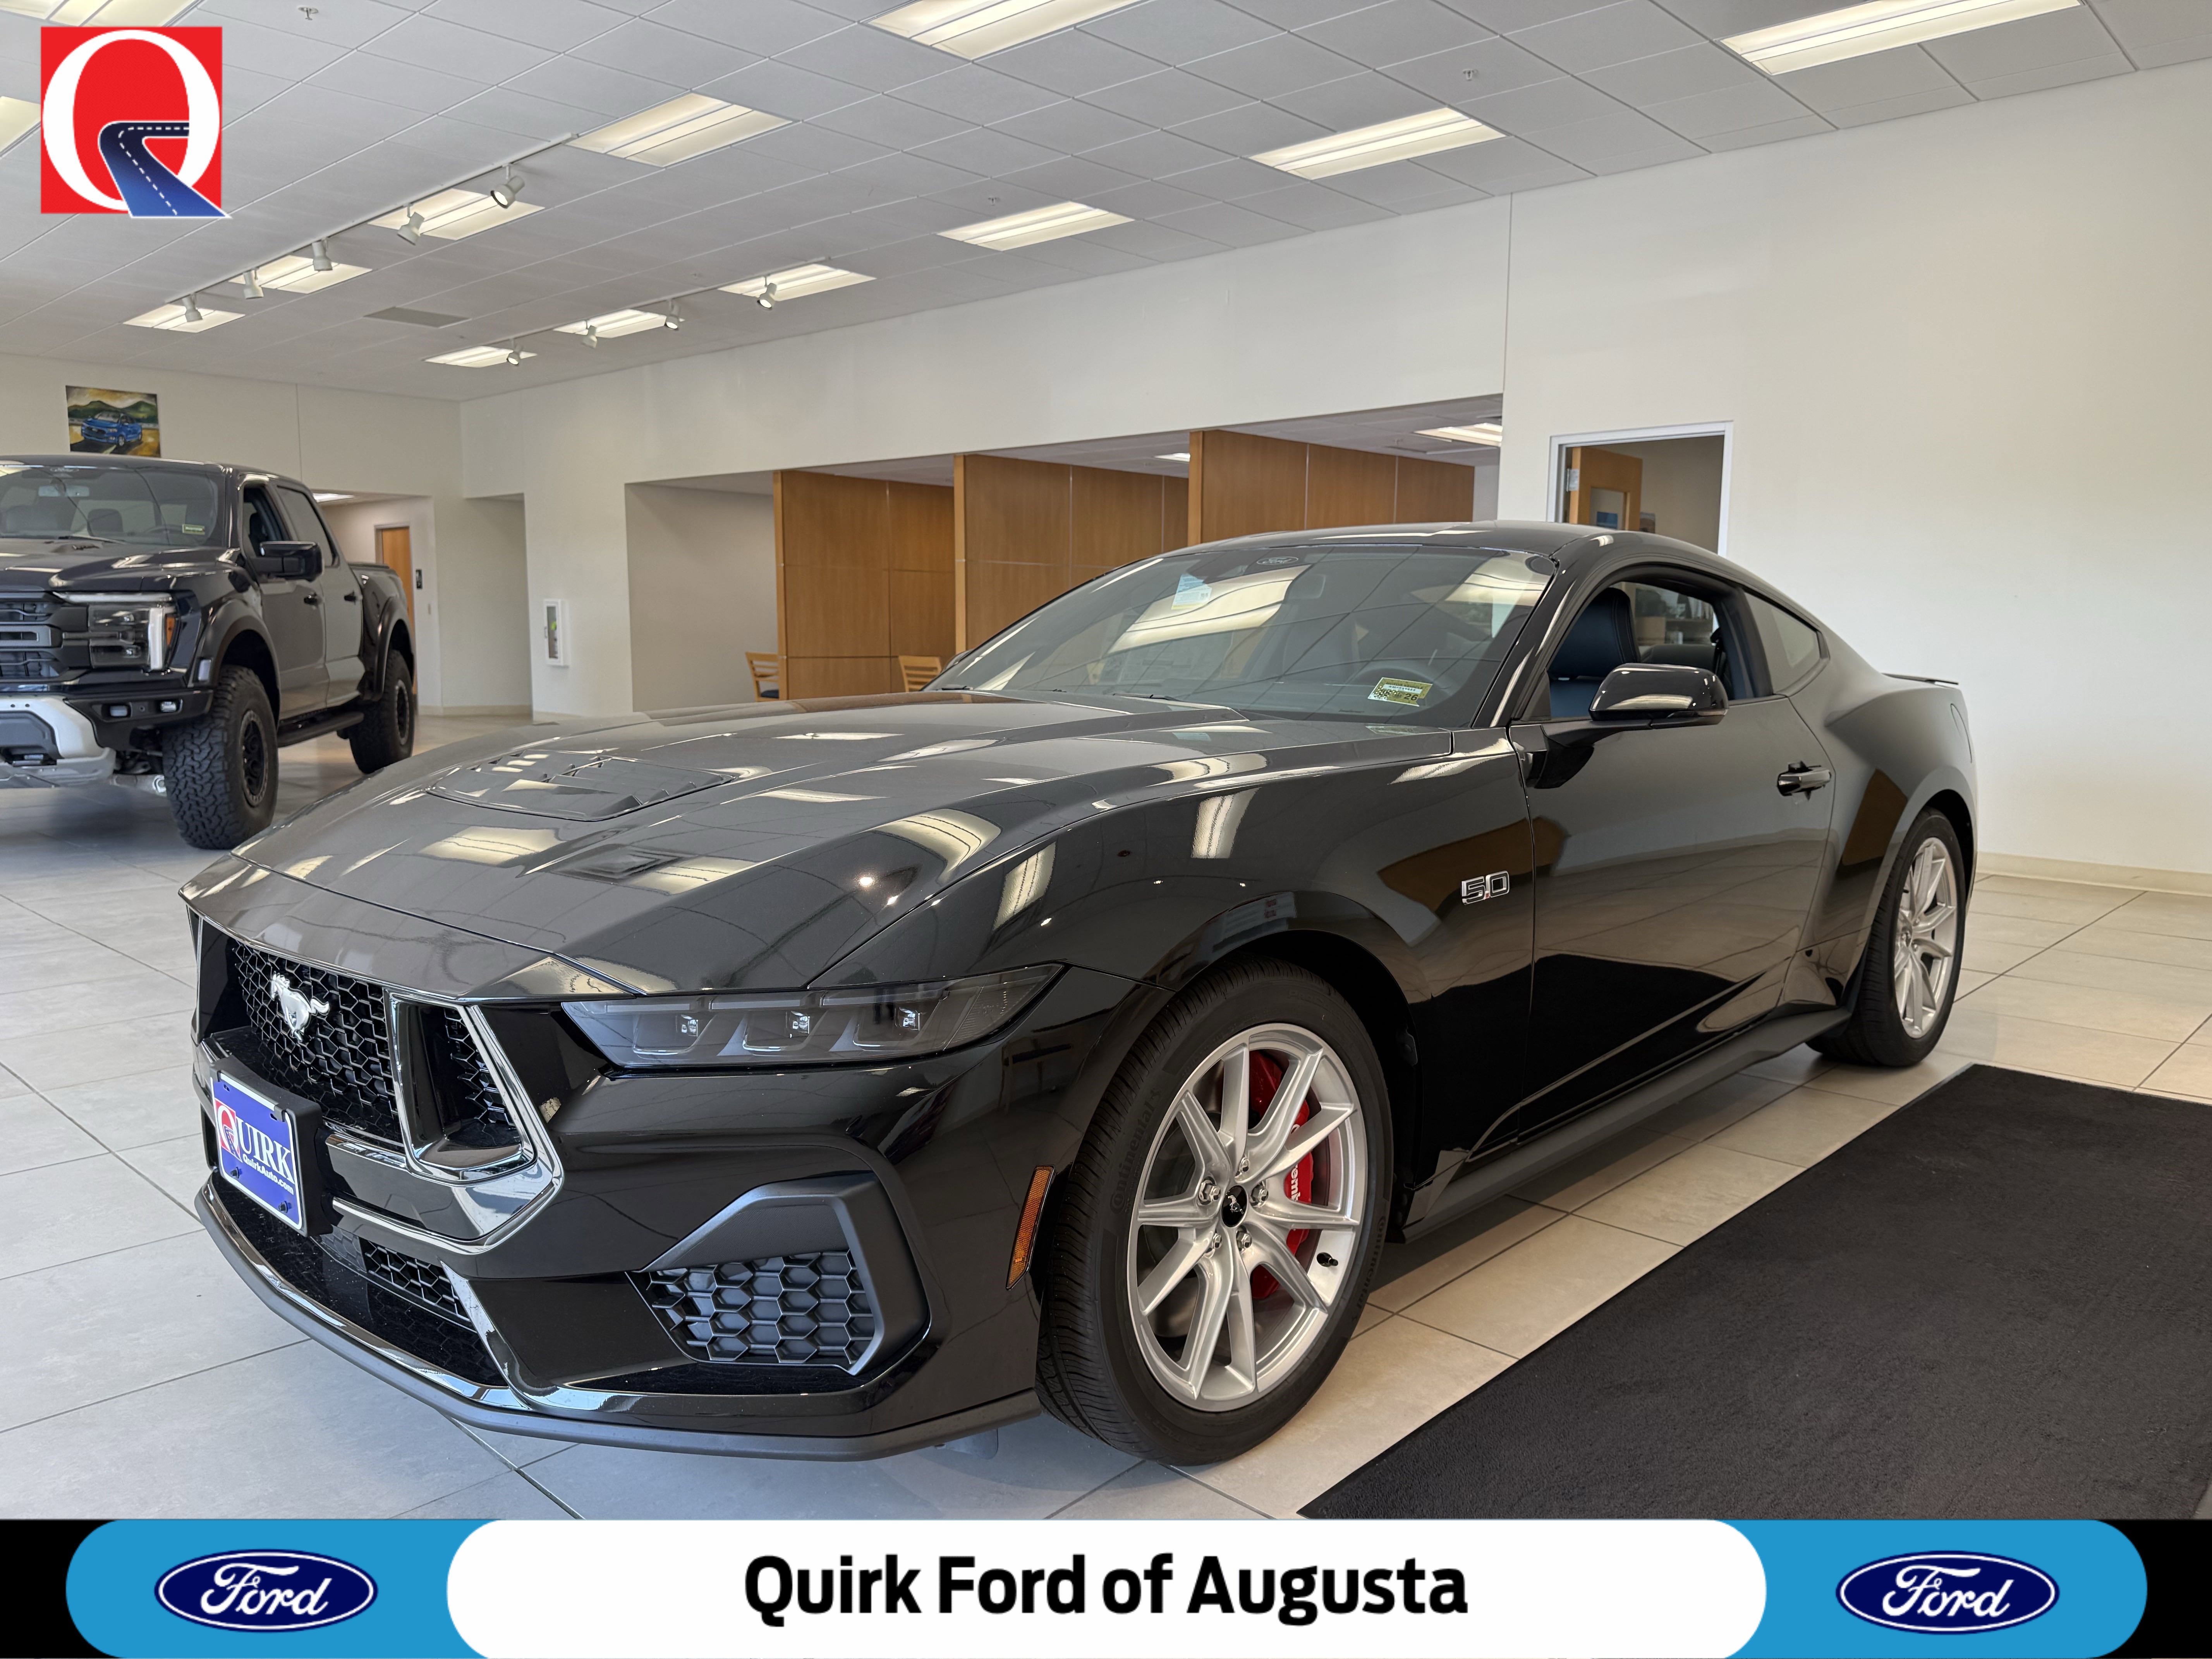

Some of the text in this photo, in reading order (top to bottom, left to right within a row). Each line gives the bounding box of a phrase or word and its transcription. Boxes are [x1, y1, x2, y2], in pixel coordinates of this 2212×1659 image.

[1404, 693, 1419, 701] 26
[1461, 870, 1510, 905] 5.0
[217, 1105, 295, 1184] QUIRK
[1109, 1099, 1155, 1214] Continental
[242, 1153, 294, 1195] QuirkAuto.com
